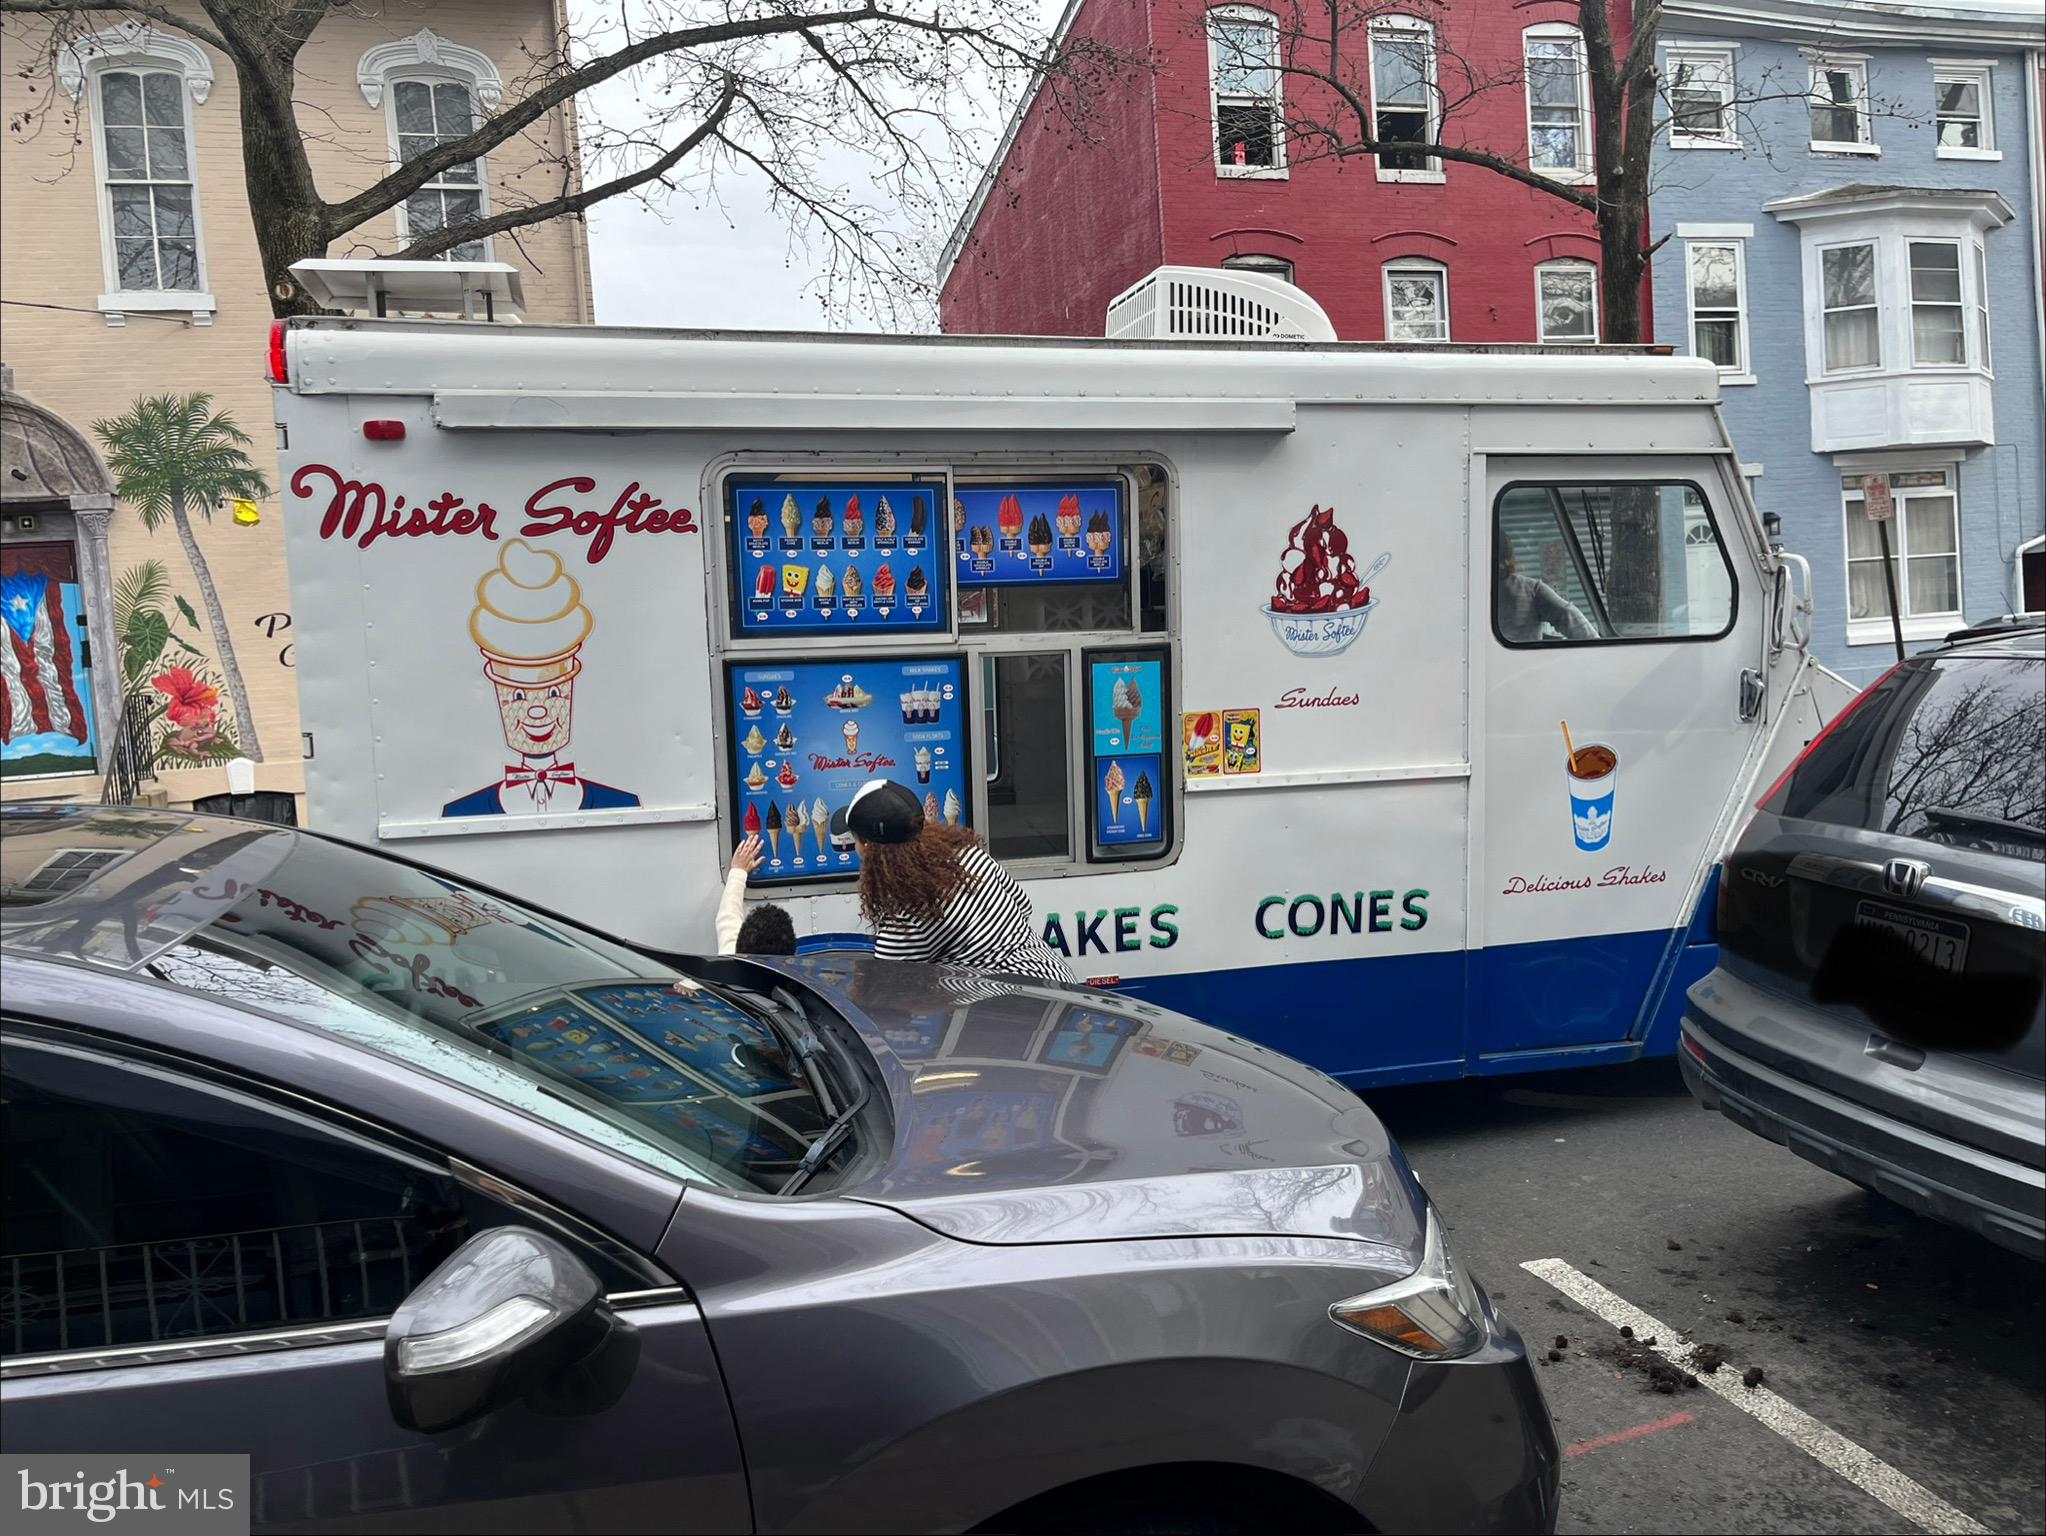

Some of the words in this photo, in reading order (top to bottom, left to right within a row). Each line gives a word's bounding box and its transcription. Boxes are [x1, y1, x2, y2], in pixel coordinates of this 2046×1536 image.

[291, 463, 500, 549] Mister
[520, 476, 698, 564] Softee
[1285, 625, 1319, 642] Mister
[1322, 622, 1355, 643] Softee
[1274, 686, 1360, 708] Sundaes
[808, 752, 851, 771] Mister
[853, 752, 896, 773] Softee
[1502, 875, 1592, 895] Delicious
[1597, 865, 1666, 887] Shakes
[1255, 887, 1430, 939] CONES
[1884, 911, 1940, 930] PENNSYLVANIA
[1089, 976, 1115, 986] DIESEL
